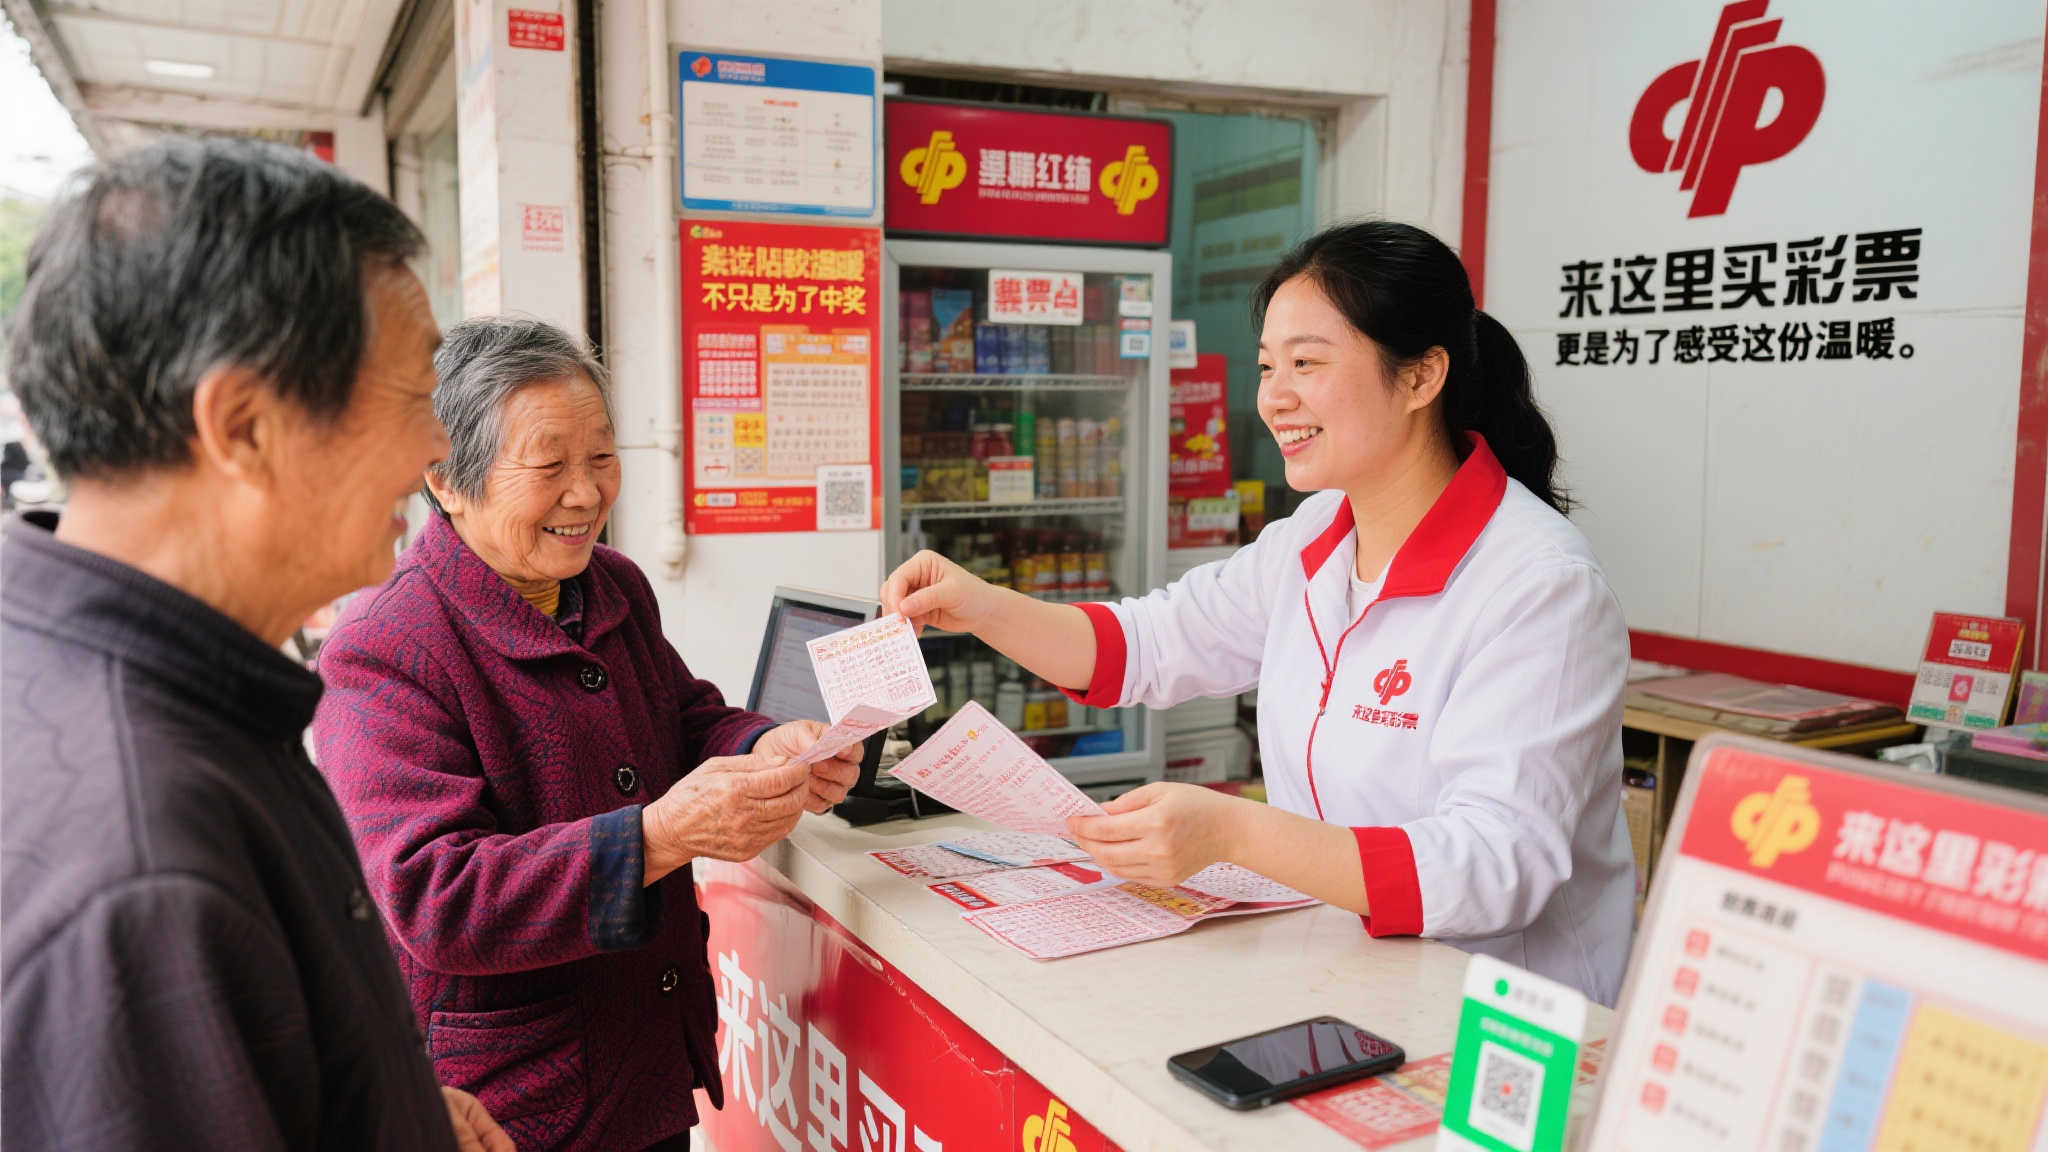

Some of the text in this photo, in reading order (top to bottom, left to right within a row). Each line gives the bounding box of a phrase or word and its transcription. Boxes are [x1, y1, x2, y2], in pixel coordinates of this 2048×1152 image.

[1558, 228, 1924, 318] 来这里买彩票
[702, 283, 867, 315] 不只是为了中奖
[1555, 316, 1916, 366] 更是为了感受这份温暖。
